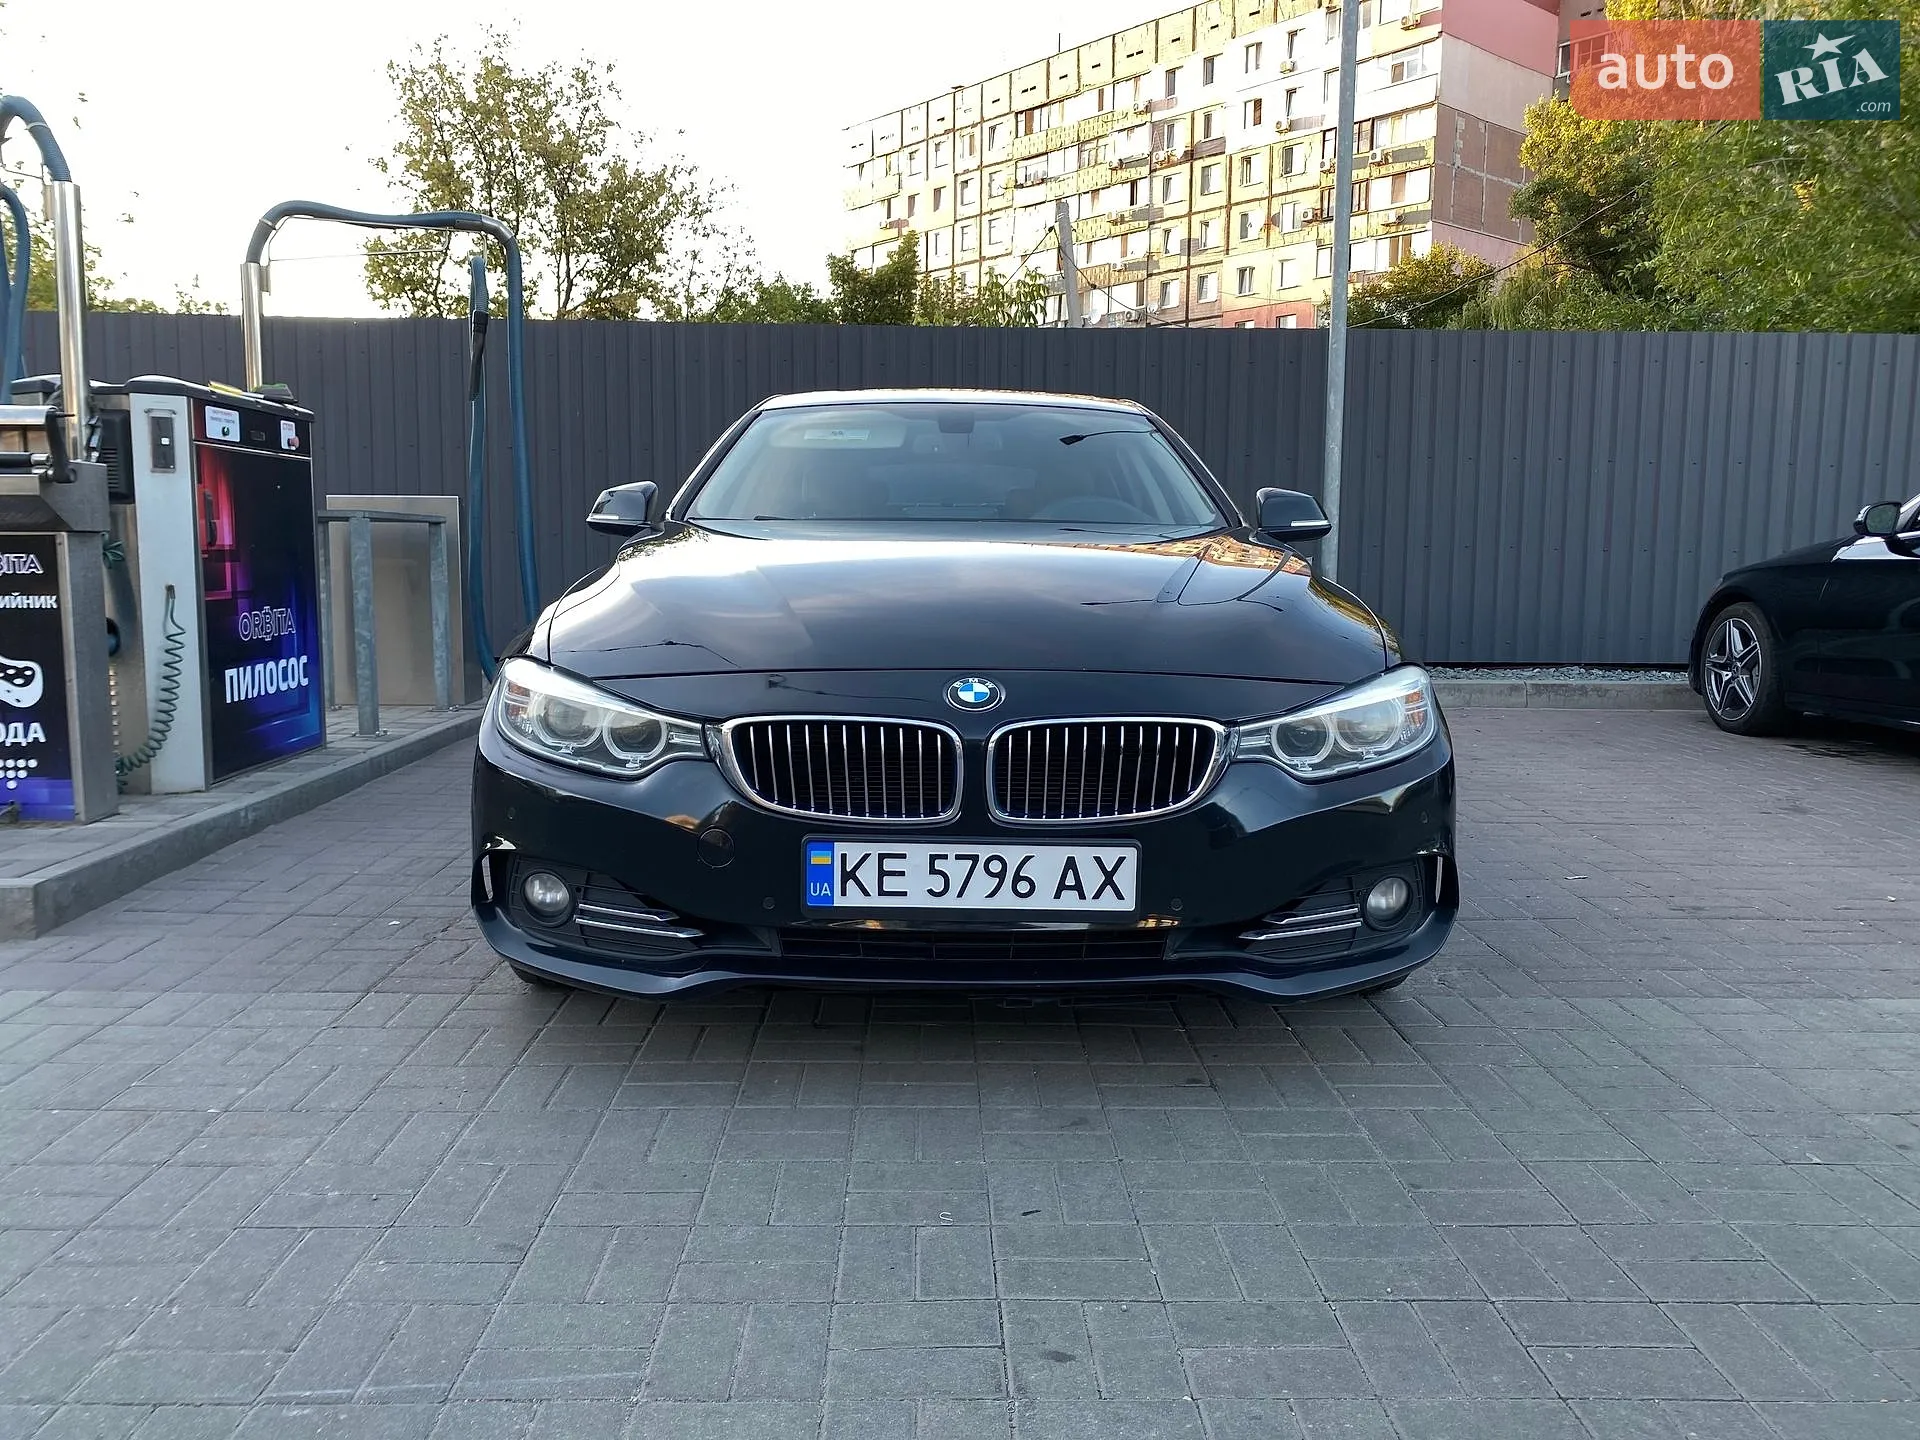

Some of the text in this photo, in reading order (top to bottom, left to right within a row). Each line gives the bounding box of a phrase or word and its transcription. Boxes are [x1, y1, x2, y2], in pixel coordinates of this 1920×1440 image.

[0, 552, 44, 576] ITA
[239, 606, 296, 641] ORBITA
[225, 655, 309, 703] ПИЛОСОС
[810, 882, 832, 898] UA
[839, 852, 1128, 901] KE 5796 AX
